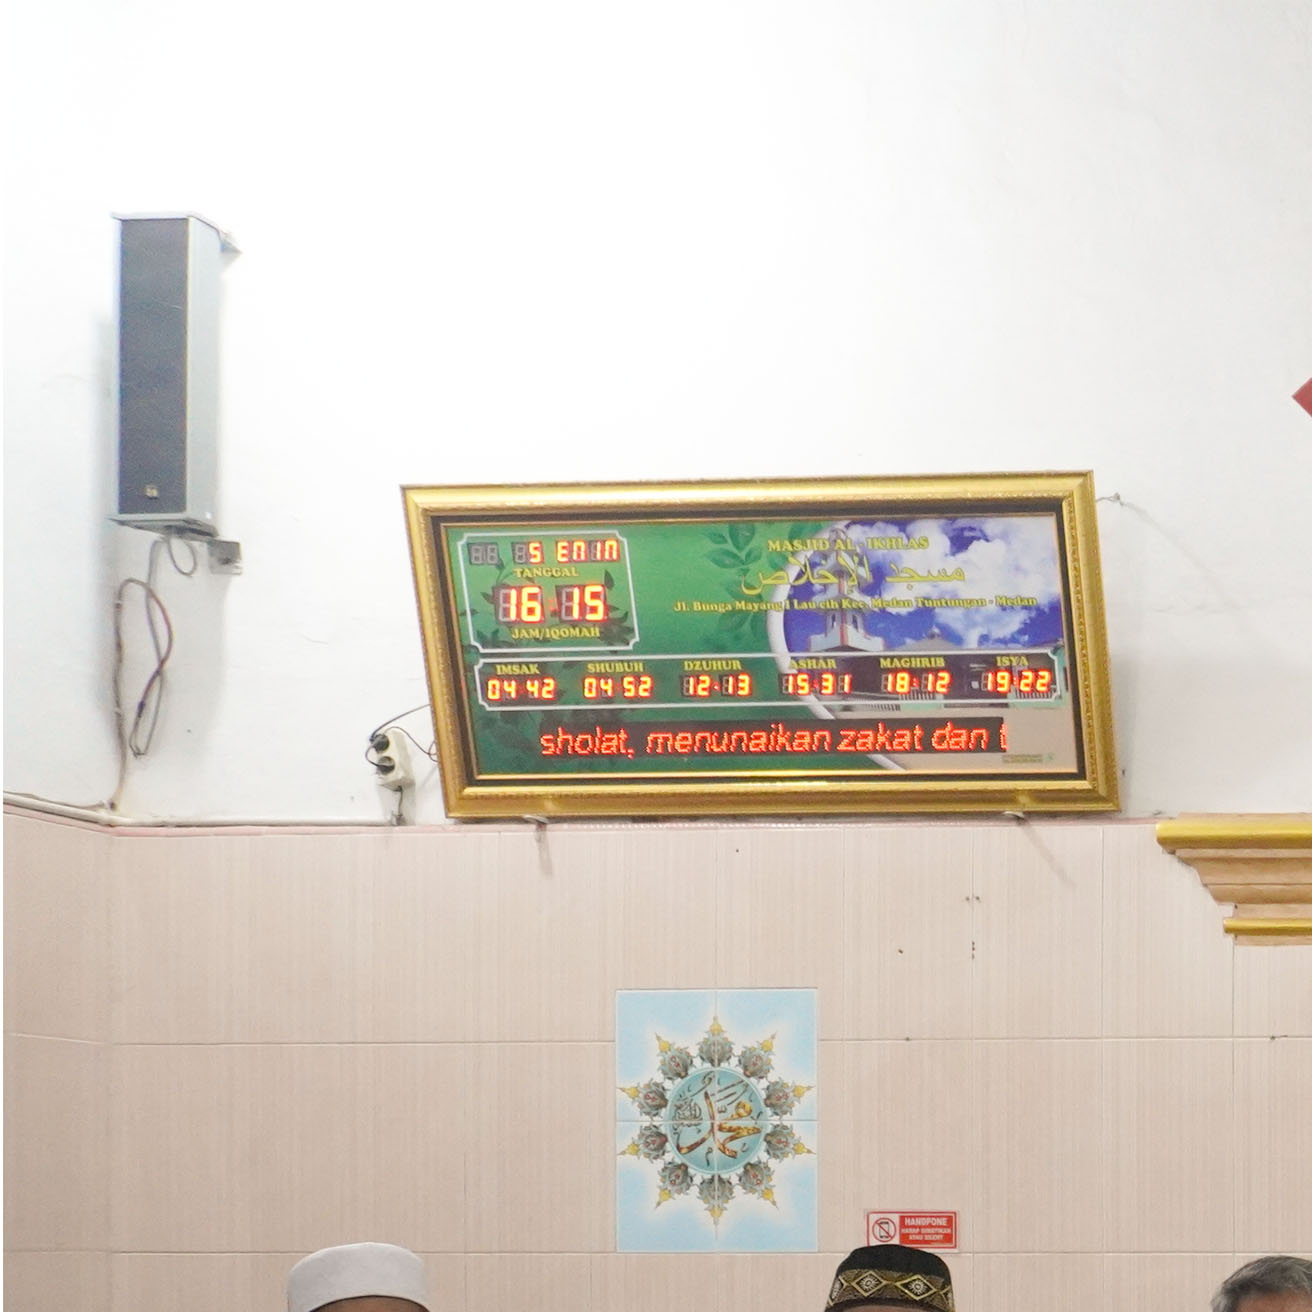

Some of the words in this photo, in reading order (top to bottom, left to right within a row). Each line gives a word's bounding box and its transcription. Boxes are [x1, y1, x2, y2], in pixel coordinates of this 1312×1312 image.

[767, 538, 830, 552] MASJID
[866, 536, 929, 550] IKHLAS
[513, 567, 579, 579] TANGGAL
[692, 601, 733, 615] Bunga
[735, 601, 783, 614] Mayang
[587, 661, 645, 674] SHUBUH
[683, 659, 742, 672] DZUHUR
[879, 656, 946, 669] MAGHRIB
[995, 655, 1029, 667] ISYA
[495, 663, 541, 676] IMSAK
[539, 725, 635, 759] sholat,
[645, 722, 833, 755] menunaikan
[836, 721, 924, 751] zakat
[930, 720, 990, 750] dan
